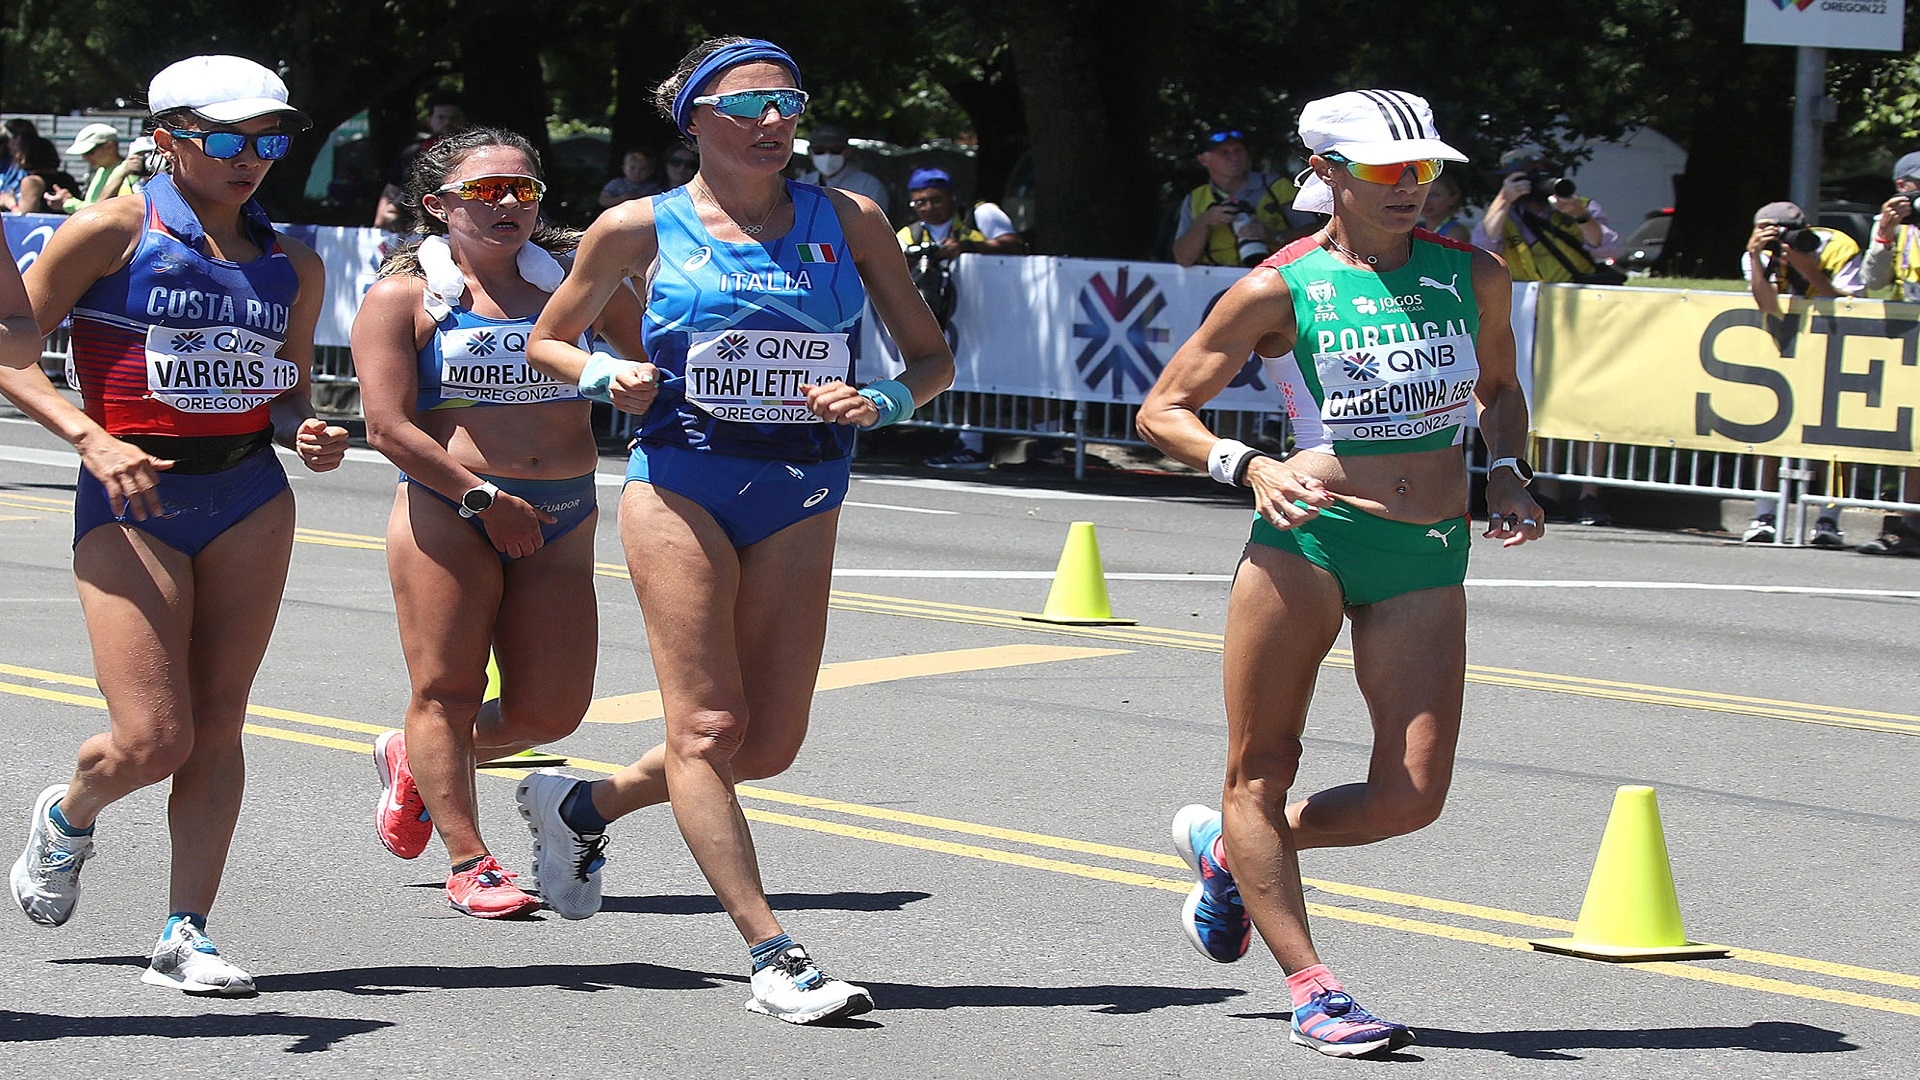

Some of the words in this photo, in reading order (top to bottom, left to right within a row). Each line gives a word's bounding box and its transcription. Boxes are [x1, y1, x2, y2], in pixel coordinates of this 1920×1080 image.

[1821, 1, 1887, 14] OREGON22
[719, 270, 813, 292] ITALIA
[146, 286, 235, 323] COSTA
[1379, 293, 1423, 311] JOGOS
[756, 337, 830, 360] QNB
[1387, 344, 1456, 373] QNB
[155, 360, 264, 388] VARGAS
[272, 365, 296, 387] 115
[691, 367, 810, 397] TRAPLETTI
[1695, 308, 1920, 451] SE
[1328, 379, 1447, 417] CABECINHA
[1450, 379, 1475, 402] 156
[1353, 414, 1450, 438] OREGON22
